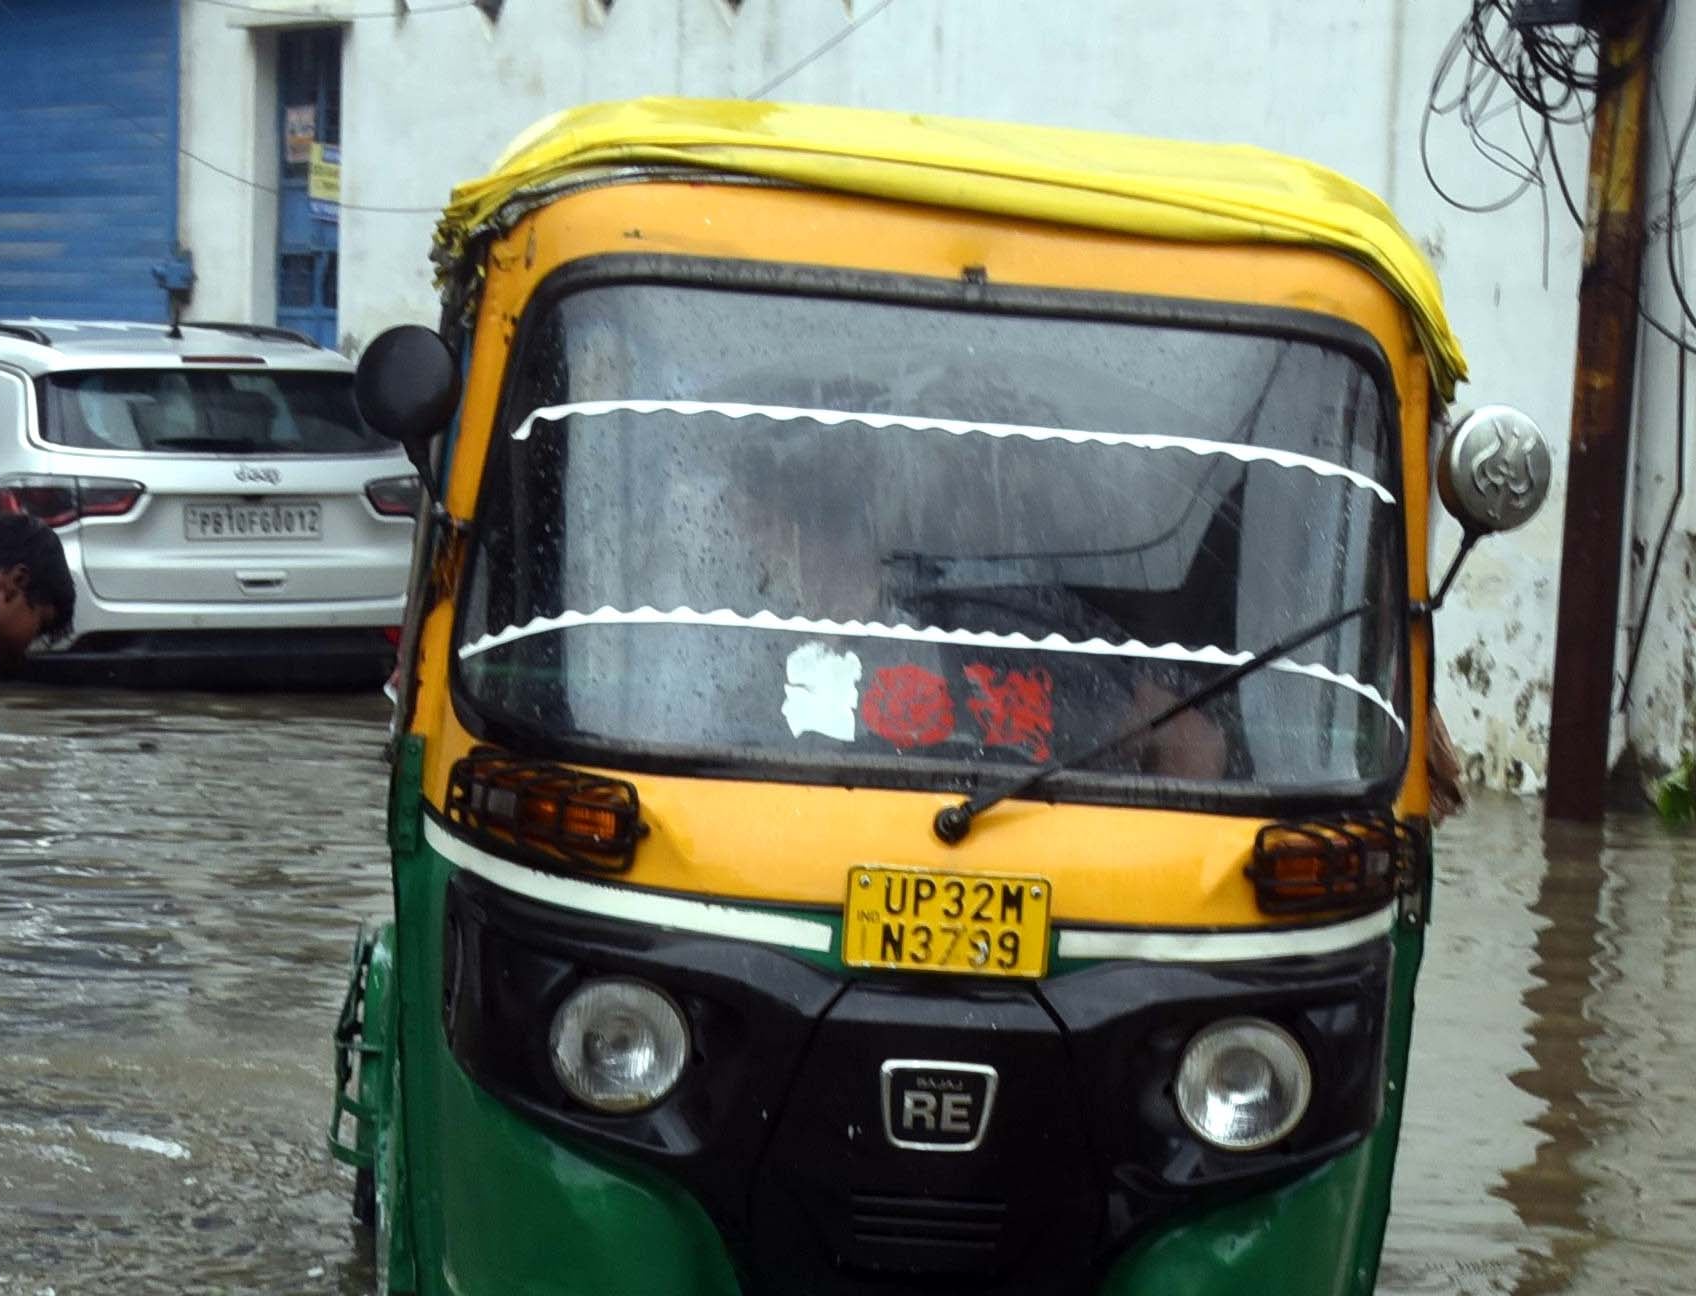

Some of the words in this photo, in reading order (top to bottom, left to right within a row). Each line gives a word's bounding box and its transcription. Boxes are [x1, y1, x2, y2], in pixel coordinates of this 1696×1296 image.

[884, 876, 1025, 924] UP32M
[880, 922, 1021, 969] N3799
[902, 1089, 973, 1133] RE
